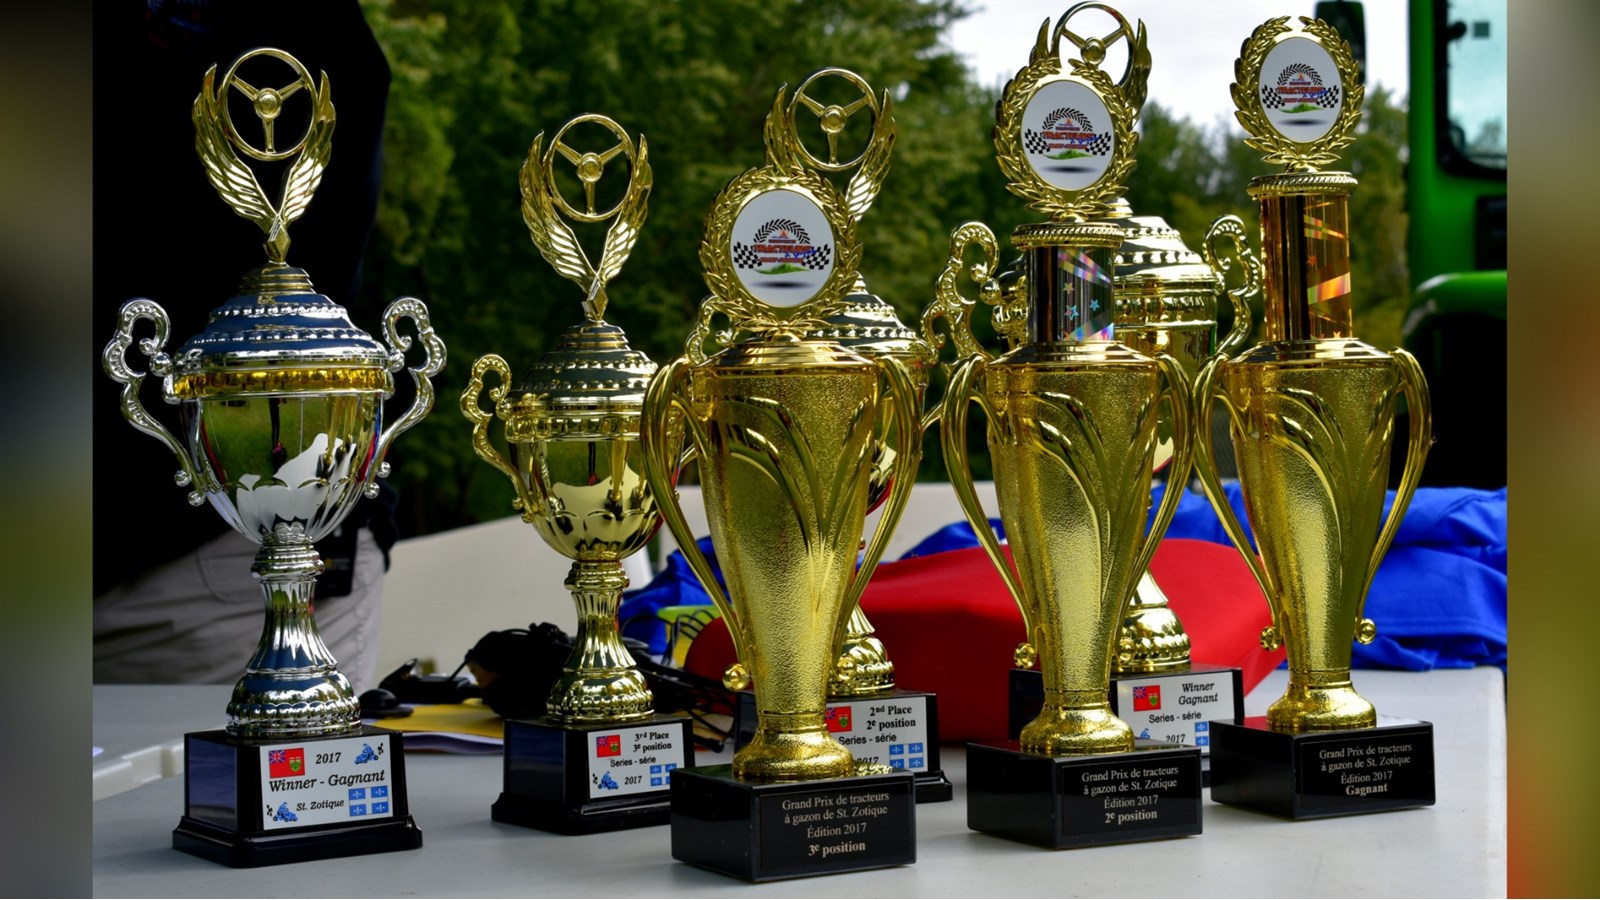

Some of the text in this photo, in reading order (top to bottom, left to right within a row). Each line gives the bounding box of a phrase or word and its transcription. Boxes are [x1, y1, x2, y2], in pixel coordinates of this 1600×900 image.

[1182, 682, 1214, 692] Winner
[1178, 693, 1218, 706] Gagnant
[870, 705, 912, 716] 2nd Place
[1149, 714, 1174, 723] Series
[1183, 712, 1202, 720] série
[867, 718, 916, 731] 2e position
[635, 732, 647, 741] 3rd
[839, 736, 866, 745] Series
[875, 733, 896, 743] série
[1166, 734, 1185, 743] 2017
[643, 742, 671, 753] position
[1319, 744, 1412, 759] Grand Prix de tracteurs
[316, 753, 341, 765] 2017
[610, 758, 632, 767] Series
[1321, 756, 1411, 772] à gazon de St. Zotique
[625, 776, 642, 784] 2017
[1082, 766, 1178, 782] Grand Prix de tracteurs
[1341, 771, 1393, 784] Édition 2017
[269, 778, 317, 792] Winner
[328, 770, 385, 788] Gagnant
[1084, 779, 1177, 796] à gazon de St. Zotique
[1346, 783, 1387, 796] Gagnant
[297, 799, 344, 812] St. Zotique
[782, 792, 889, 810] Grand Prix de tracteurs
[1104, 795, 1158, 809] Édition 2017
[785, 806, 888, 825] à gazon de St. Zotique
[1105, 810, 1157, 825] 2e position
[807, 823, 867, 838] Édition 2017
[808, 842, 866, 857] 3e position
